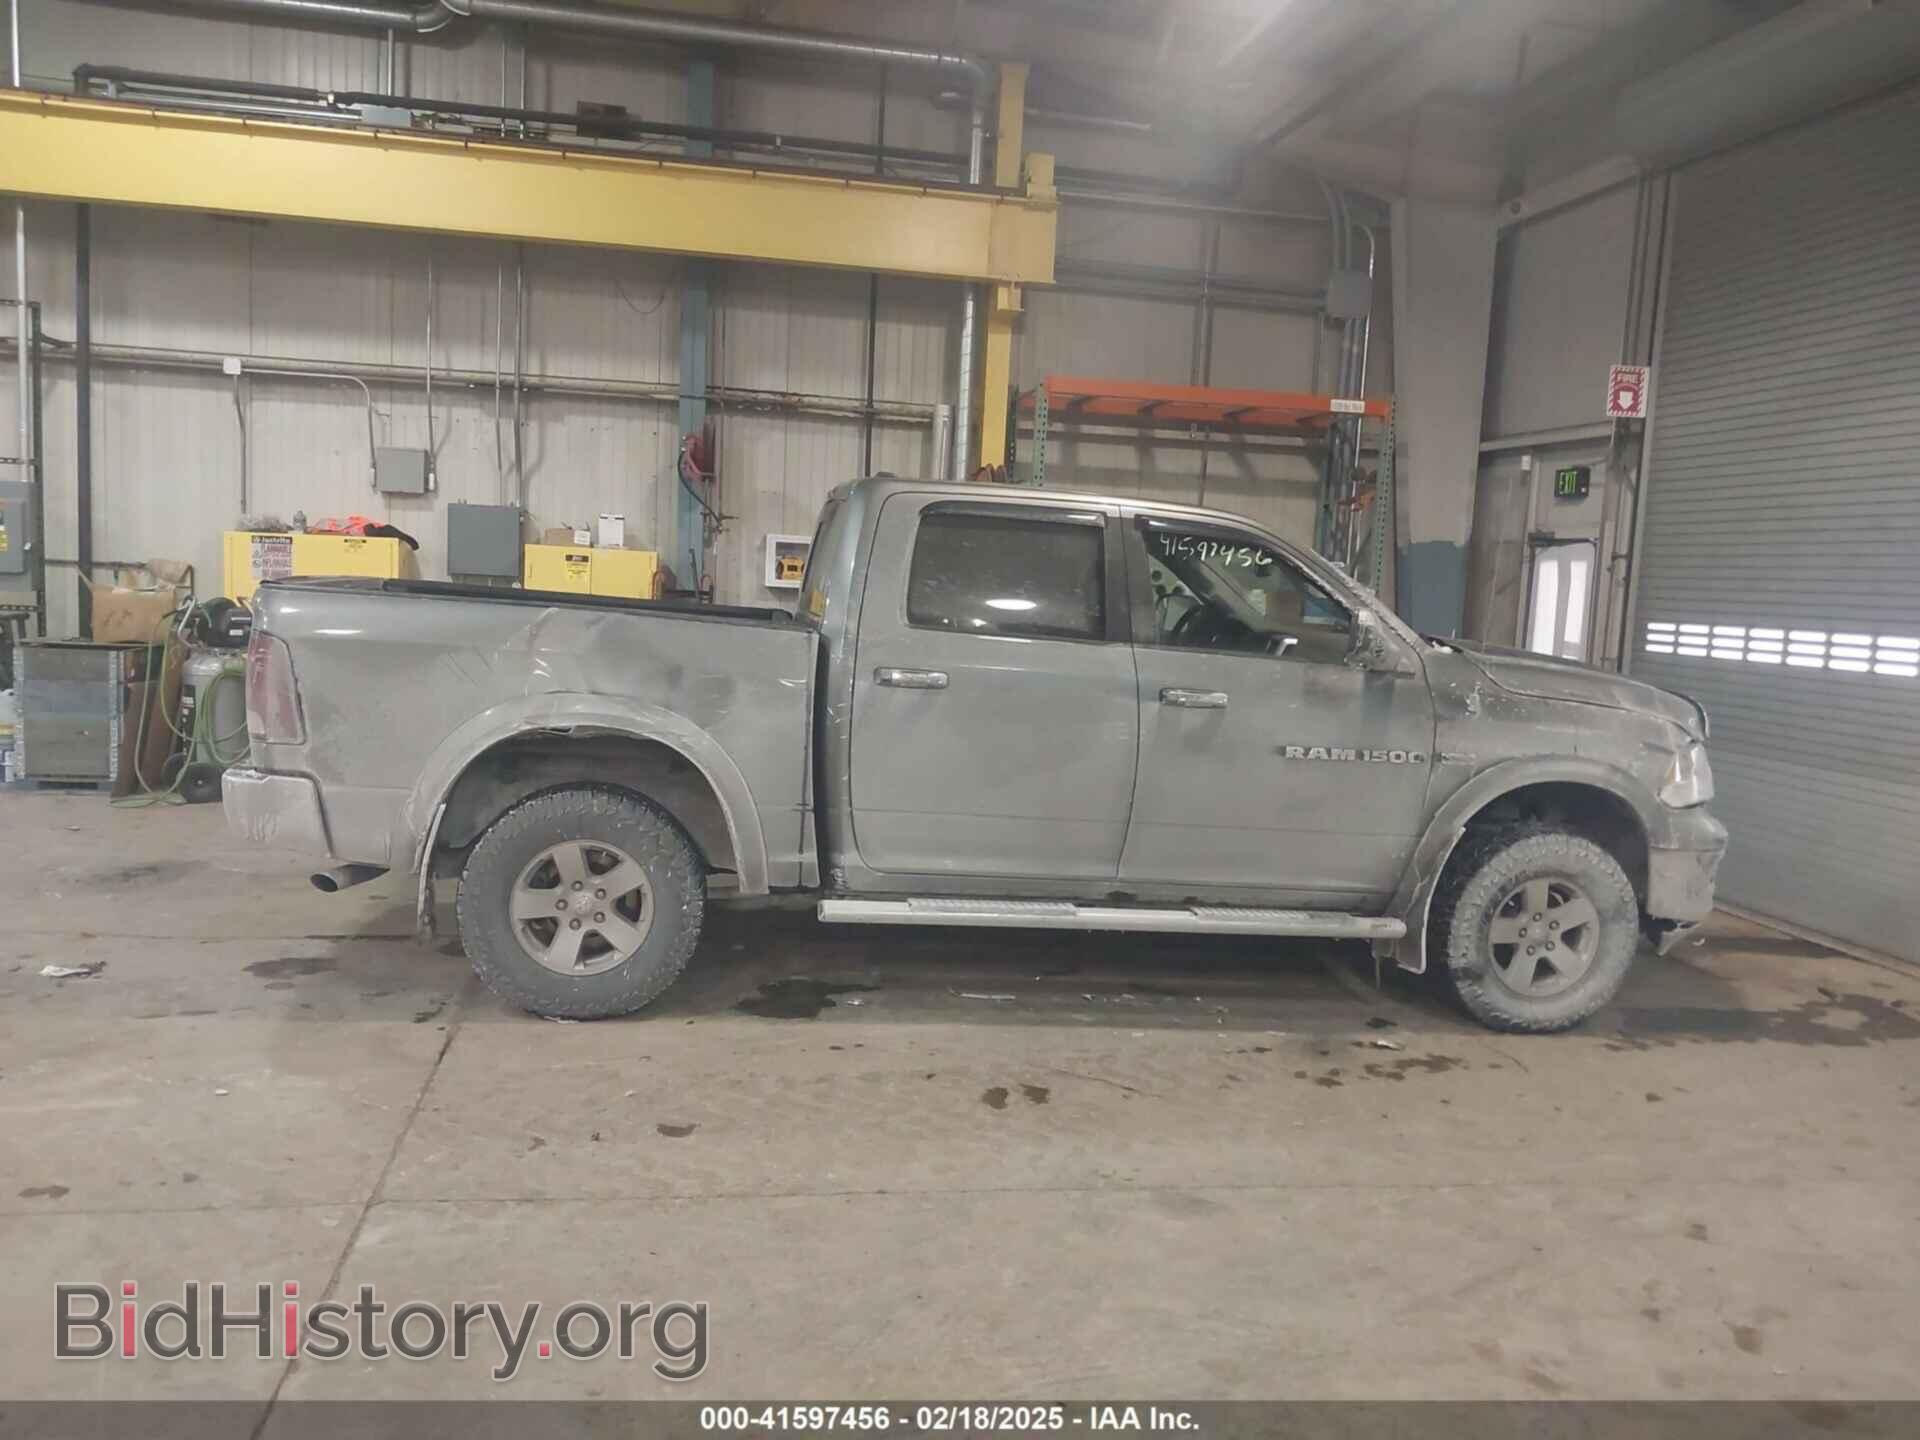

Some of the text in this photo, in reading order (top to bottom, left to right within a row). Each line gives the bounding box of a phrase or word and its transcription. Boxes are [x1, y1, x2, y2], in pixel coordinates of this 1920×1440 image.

[1616, 373, 1640, 383] FIRE
[1559, 471, 1576, 494] EXIT
[1285, 745, 1355, 761] RAM
